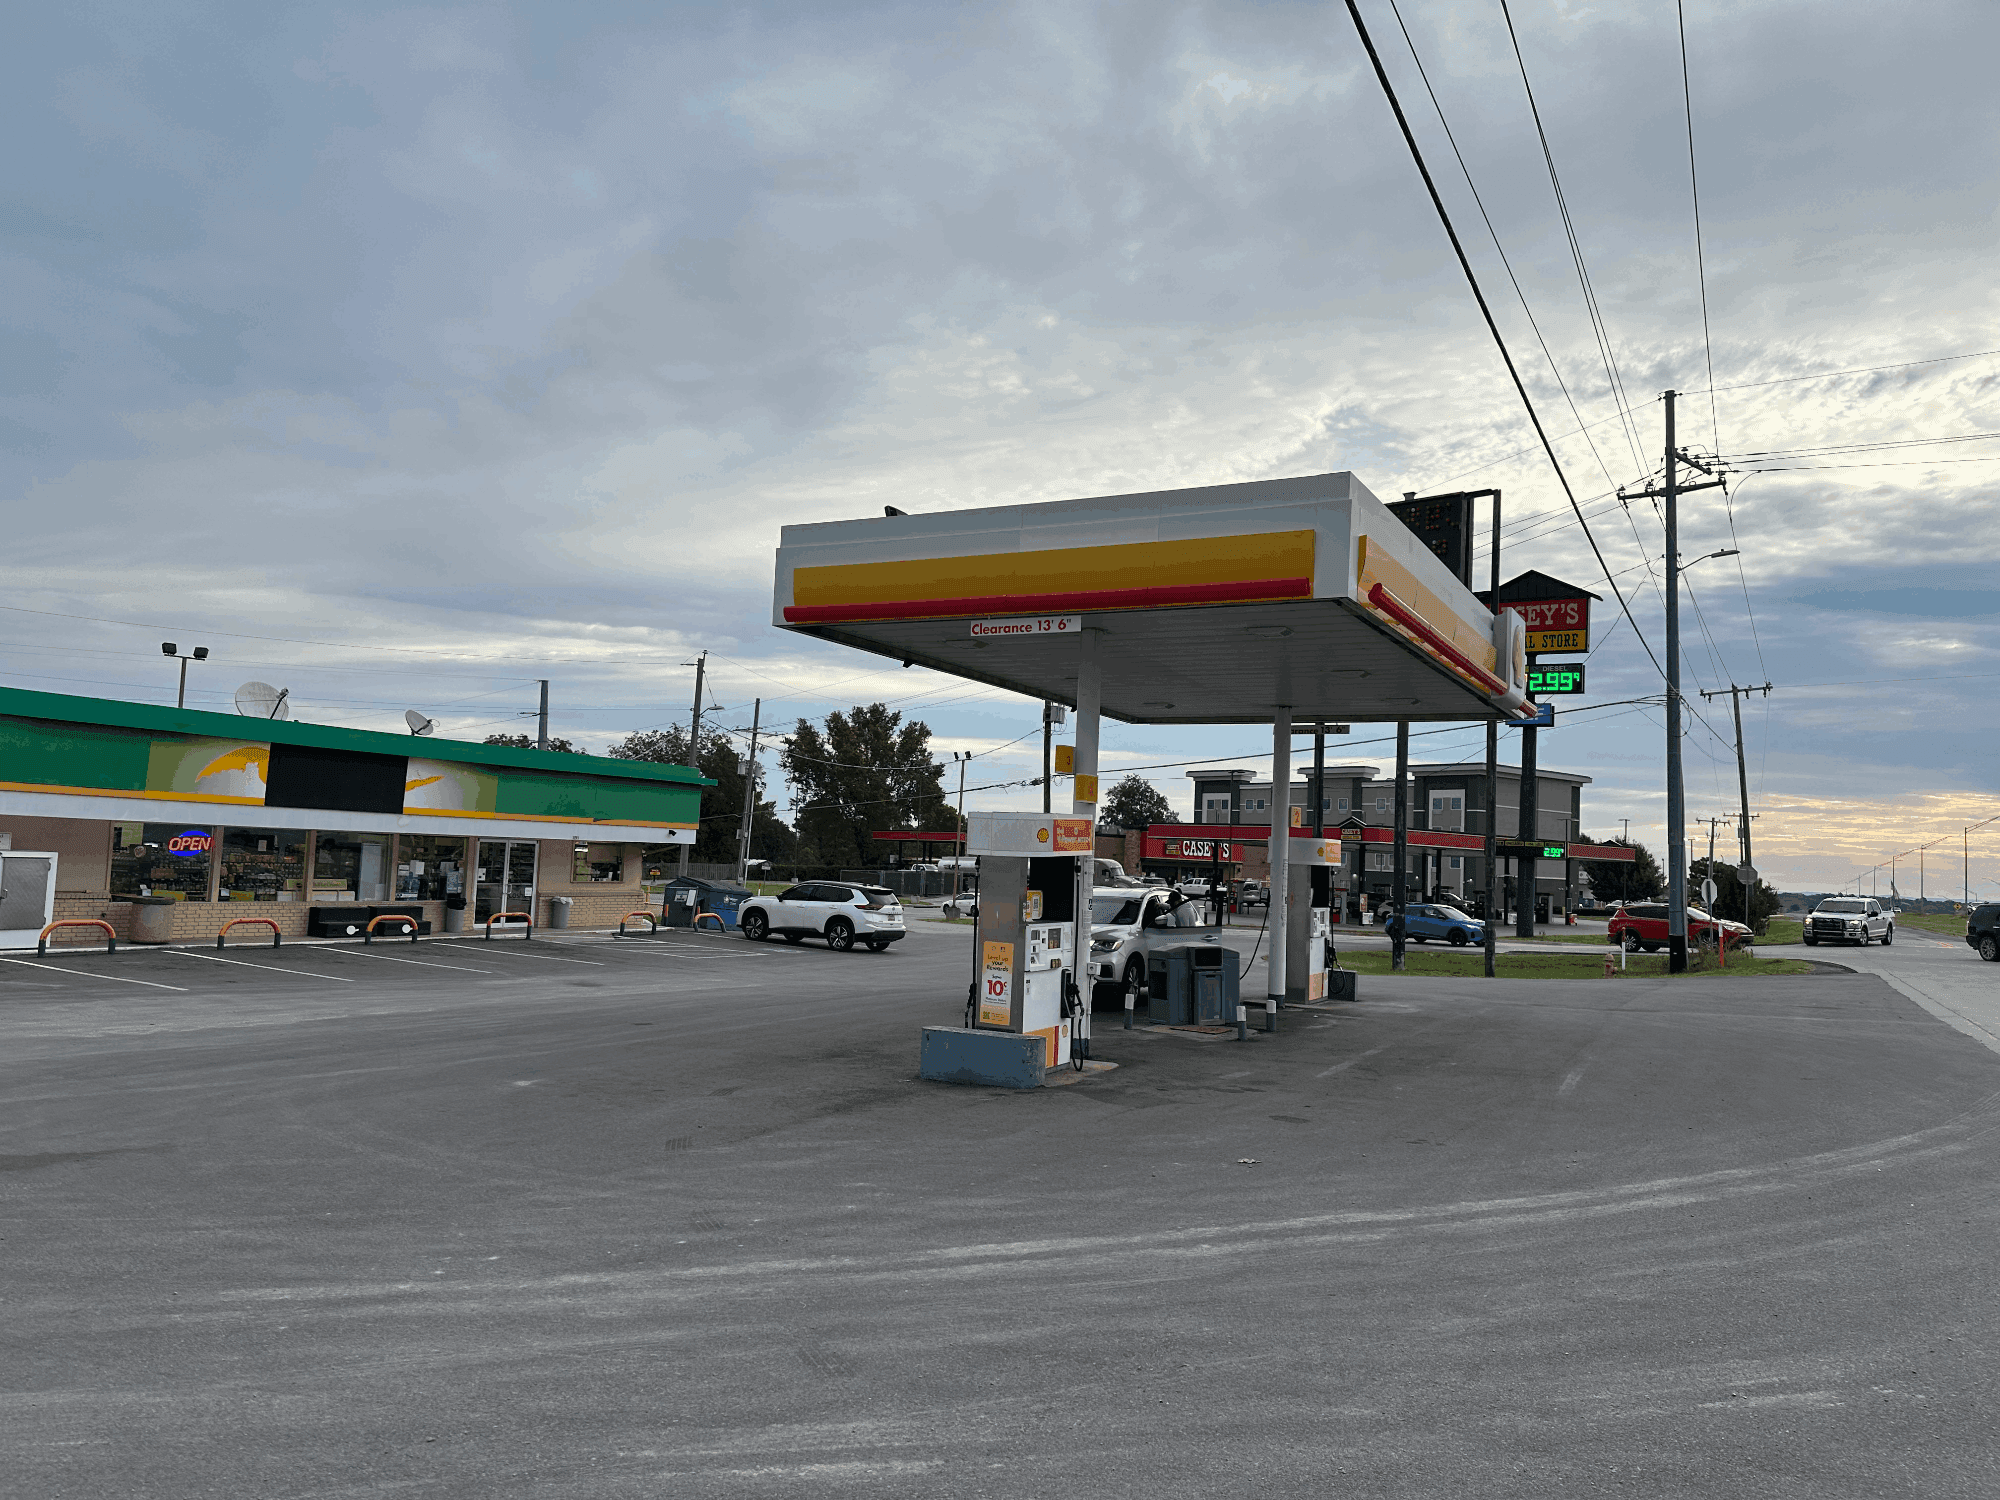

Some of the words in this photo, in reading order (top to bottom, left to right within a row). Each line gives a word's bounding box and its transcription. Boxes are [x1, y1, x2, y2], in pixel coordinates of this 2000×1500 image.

[971, 622, 1032, 635] Clearance
[1037, 619, 1054, 631] 13'
[1057, 618, 1071, 630] 6"
[1542, 633, 1578, 649] STORE
[1320, 726, 1333, 734] 13'
[168, 836, 212, 851] OPEN
